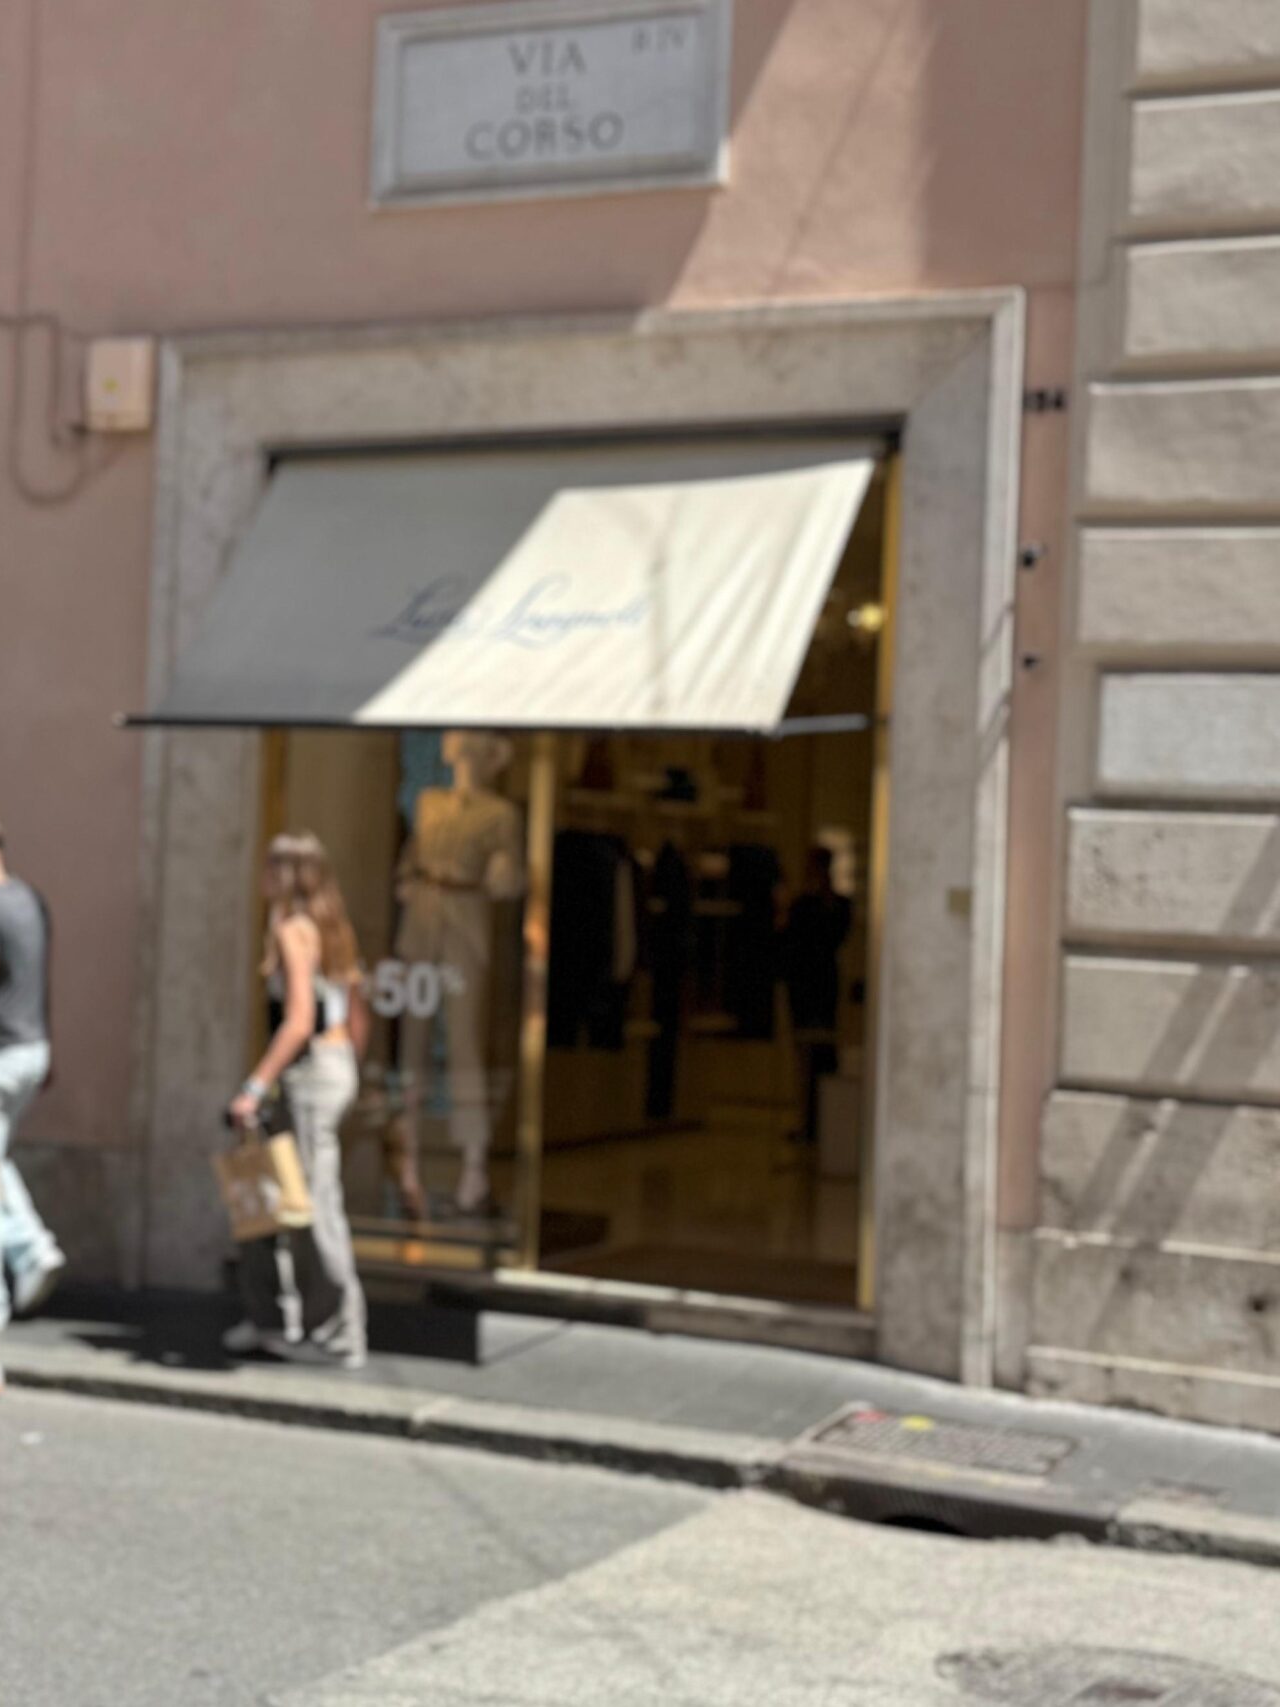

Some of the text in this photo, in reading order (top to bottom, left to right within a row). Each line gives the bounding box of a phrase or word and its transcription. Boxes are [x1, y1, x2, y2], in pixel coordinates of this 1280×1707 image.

[507, 39, 587, 76] VIA
[516, 82, 575, 113] DEL
[463, 110, 625, 161] CORSO
